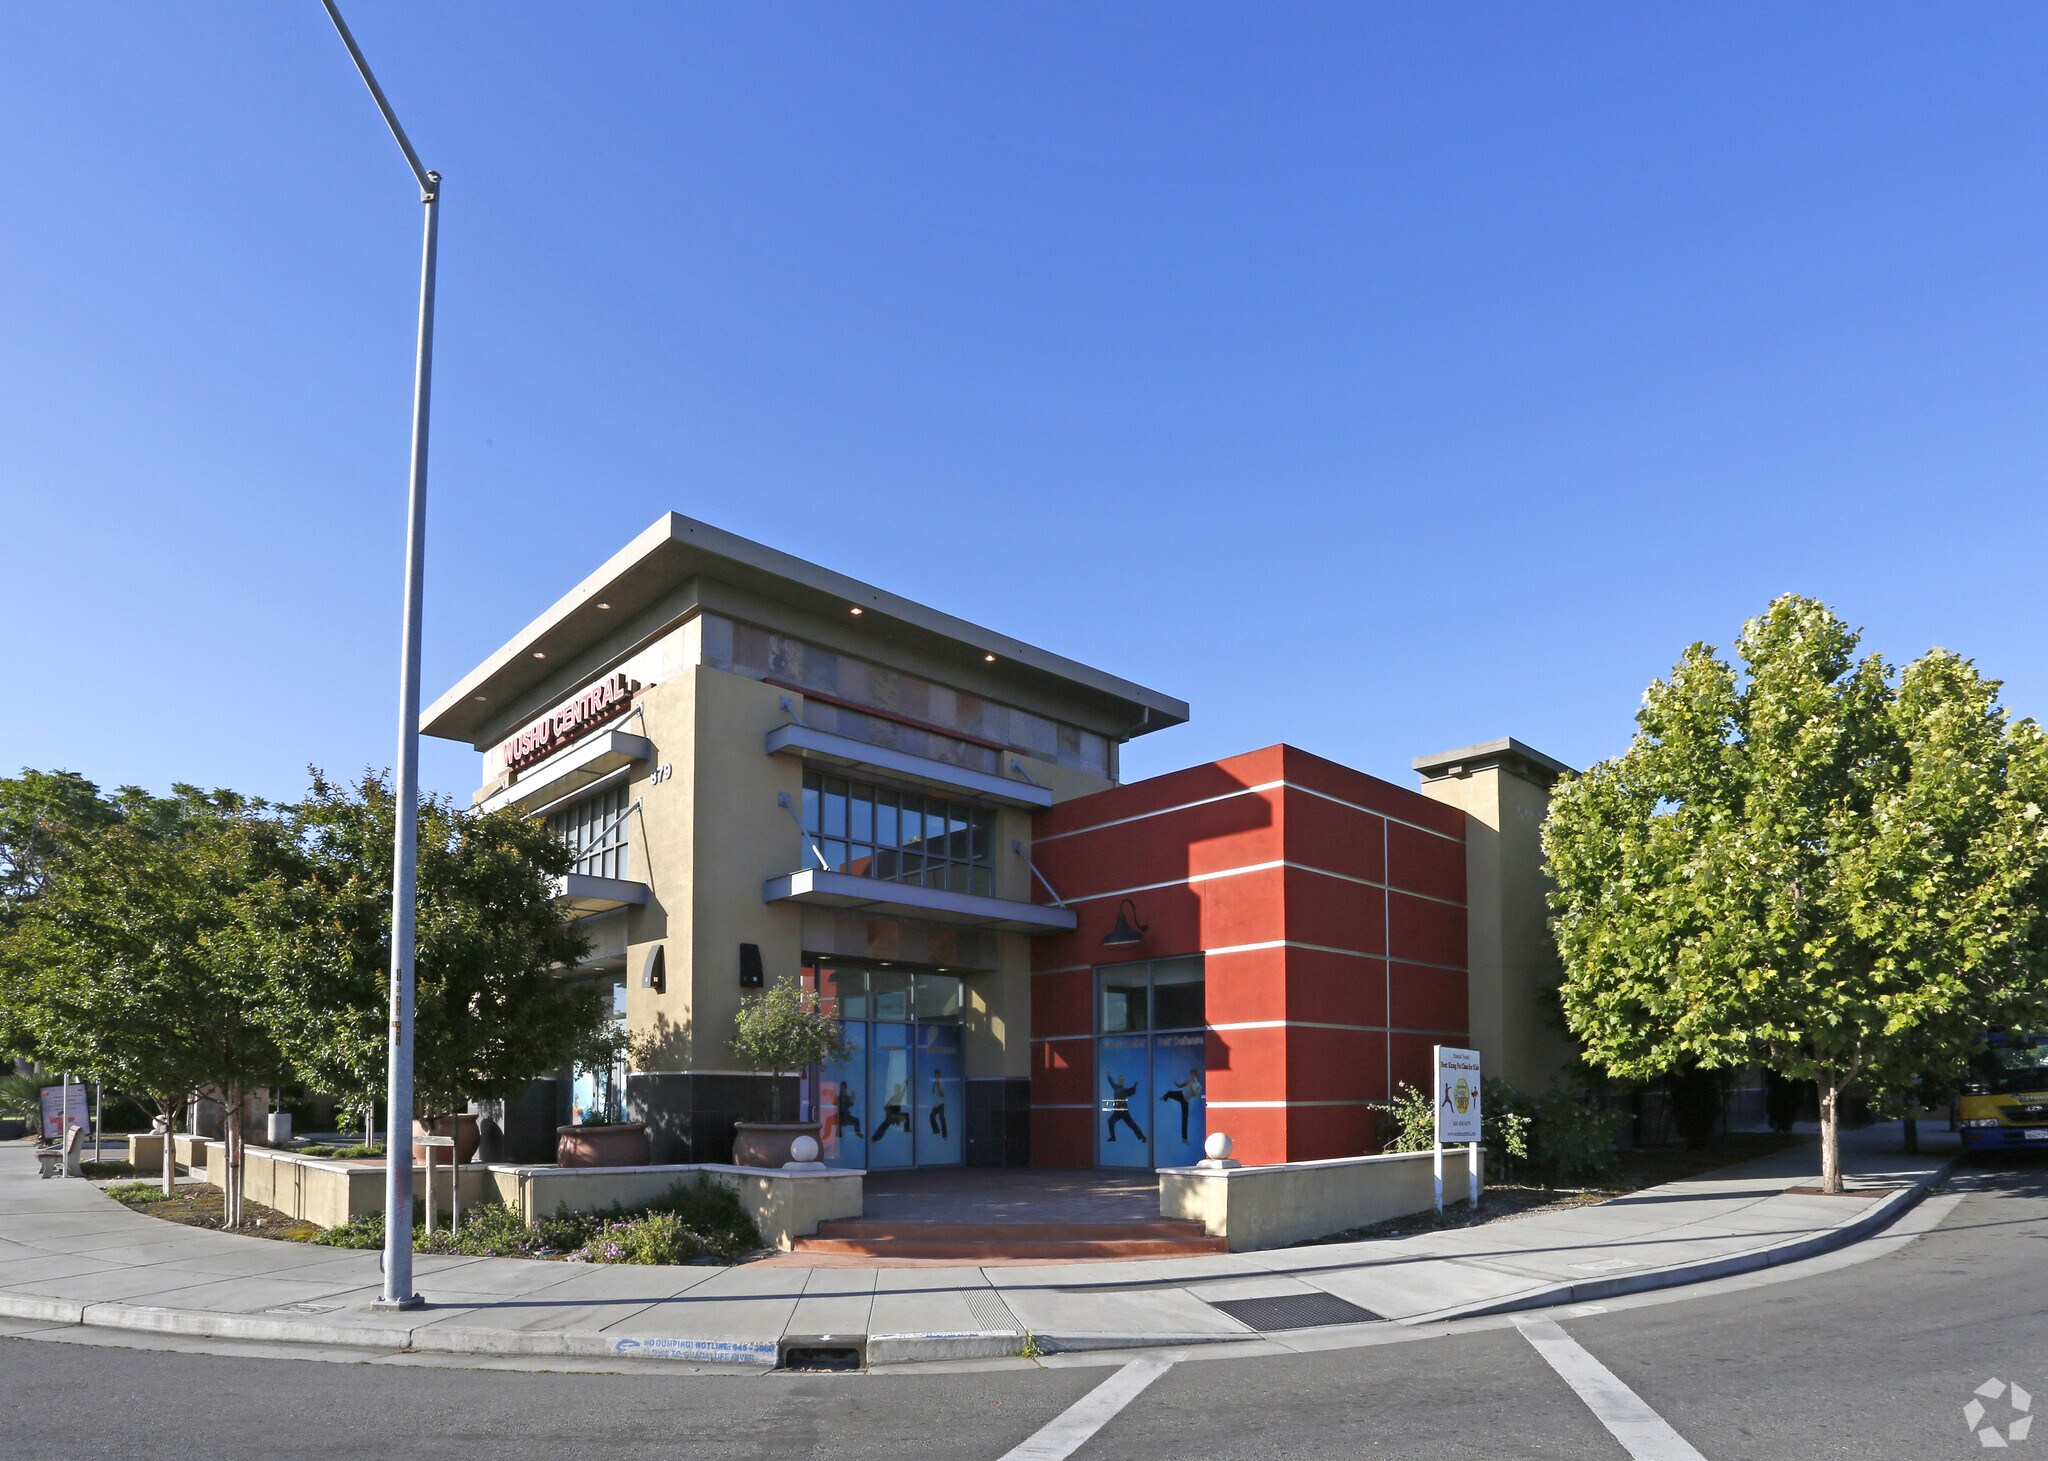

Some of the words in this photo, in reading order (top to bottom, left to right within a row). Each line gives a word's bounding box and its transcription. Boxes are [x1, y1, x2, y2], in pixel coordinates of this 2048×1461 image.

[503, 718, 551, 766] WUSHU
[553, 673, 627, 737] CENTRAL
[650, 762, 672, 786] 879
[644, 1339, 655, 1347] NO
[655, 1339, 694, 1349] DUMPING!
